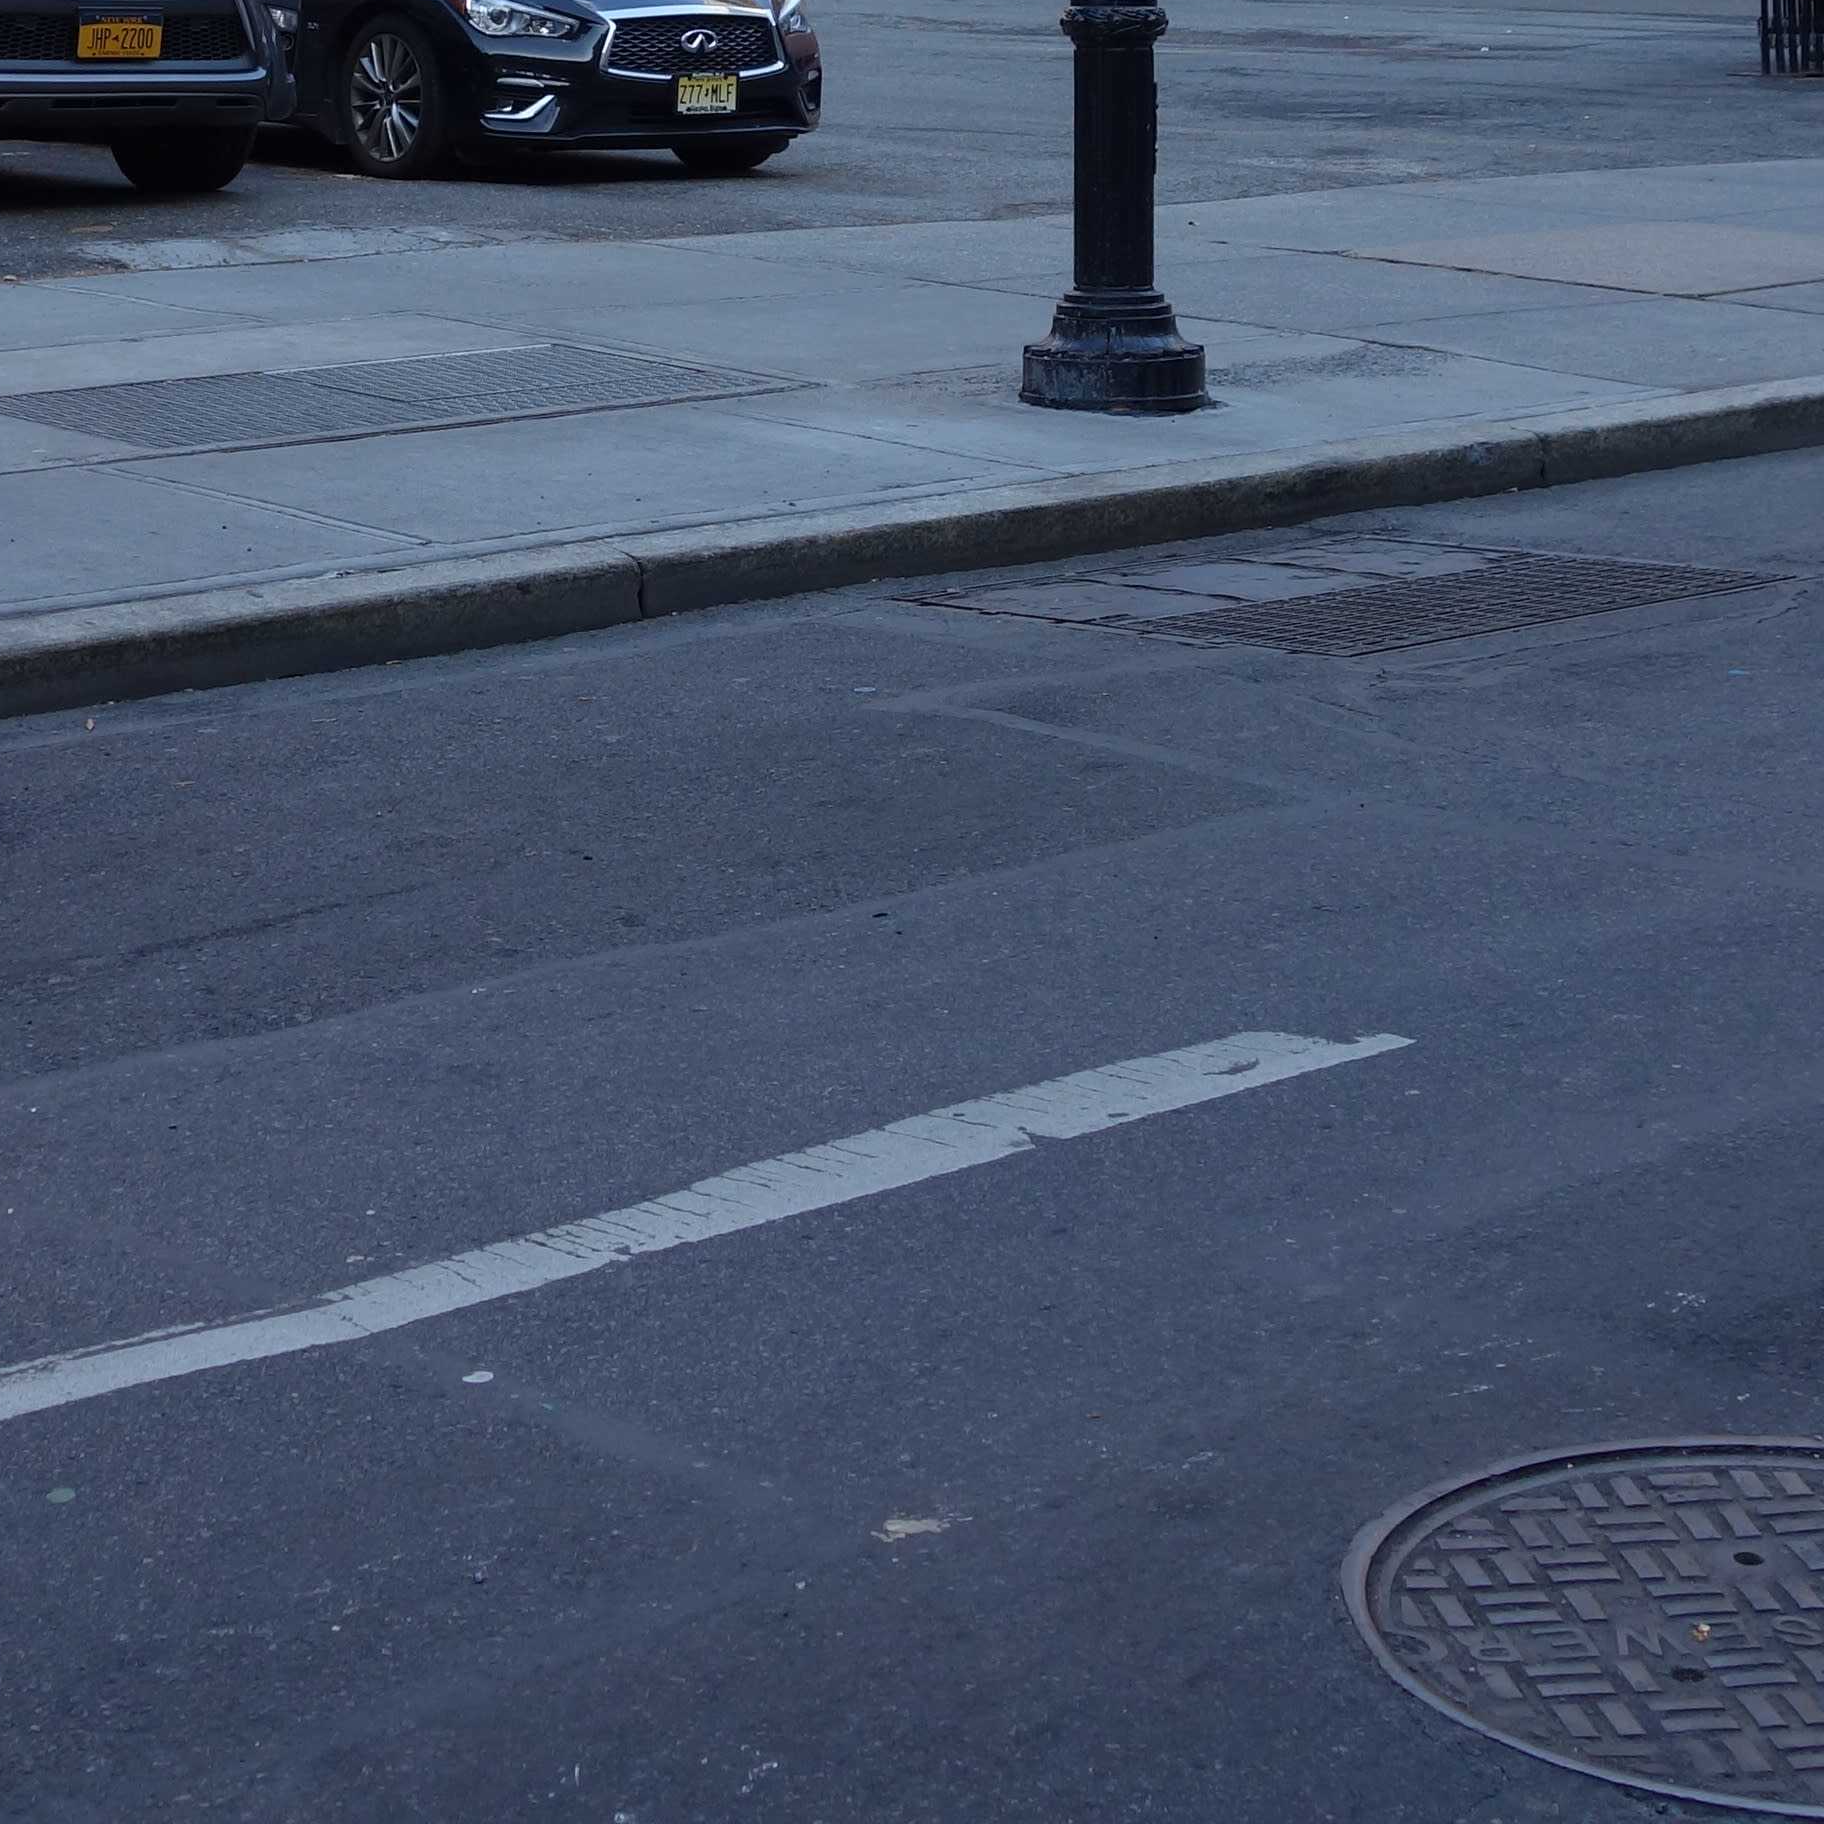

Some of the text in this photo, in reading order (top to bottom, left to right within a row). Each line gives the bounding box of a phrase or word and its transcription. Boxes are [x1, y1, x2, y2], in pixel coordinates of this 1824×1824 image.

[86, 27, 154, 49] JHP 2200
[710, 82, 735, 104] MLF
[1477, 1614, 1824, 1665] SEWER
